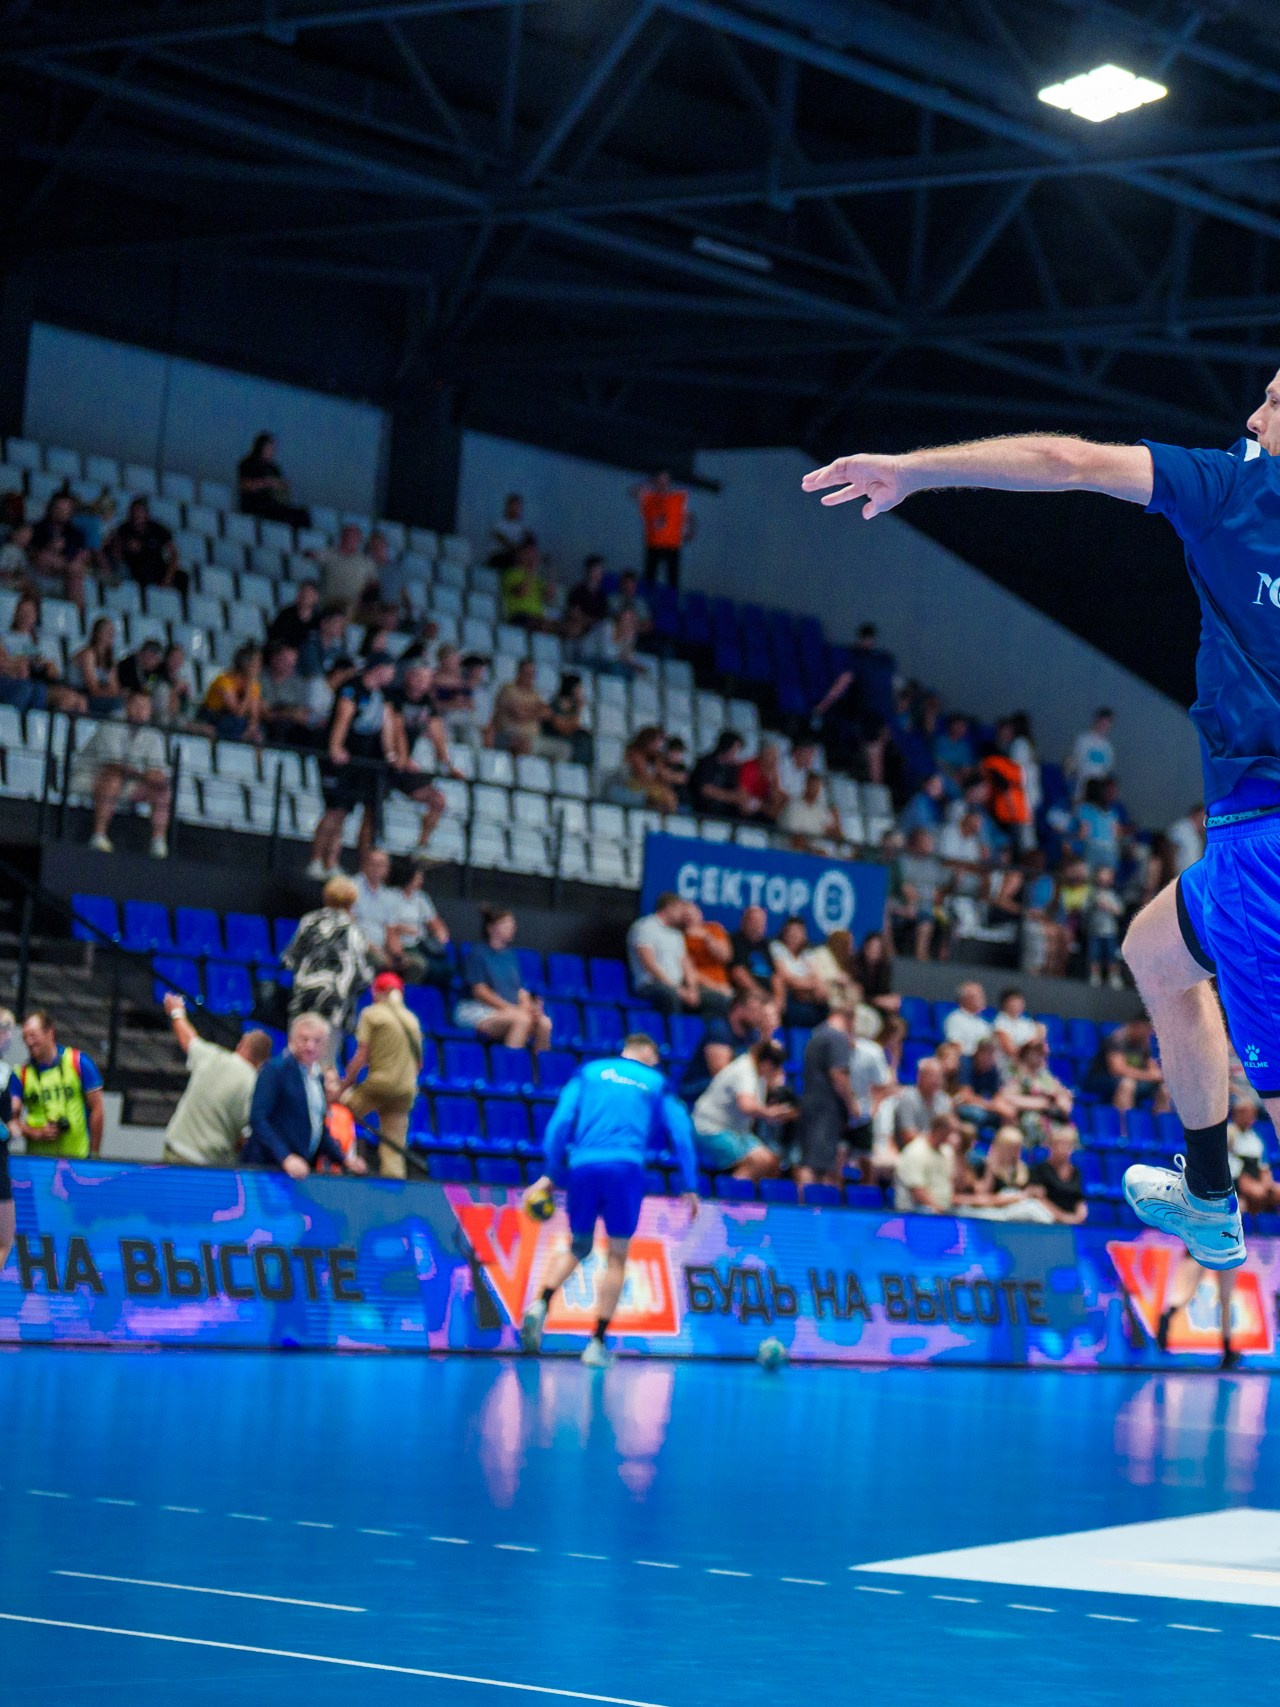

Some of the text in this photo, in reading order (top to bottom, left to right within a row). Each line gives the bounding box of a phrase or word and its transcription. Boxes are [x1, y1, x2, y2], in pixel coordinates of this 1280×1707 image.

[677, 863, 810, 918] СЕКТОР
[1243, 1060, 1269, 1068] KELME
[16, 1234, 363, 1301] НА ВЫСОТЕ
[685, 1265, 798, 1324] БУДЬ
[809, 1268, 873, 1323] НА
[880, 1274, 1050, 1325] ВЫСОТЕ
